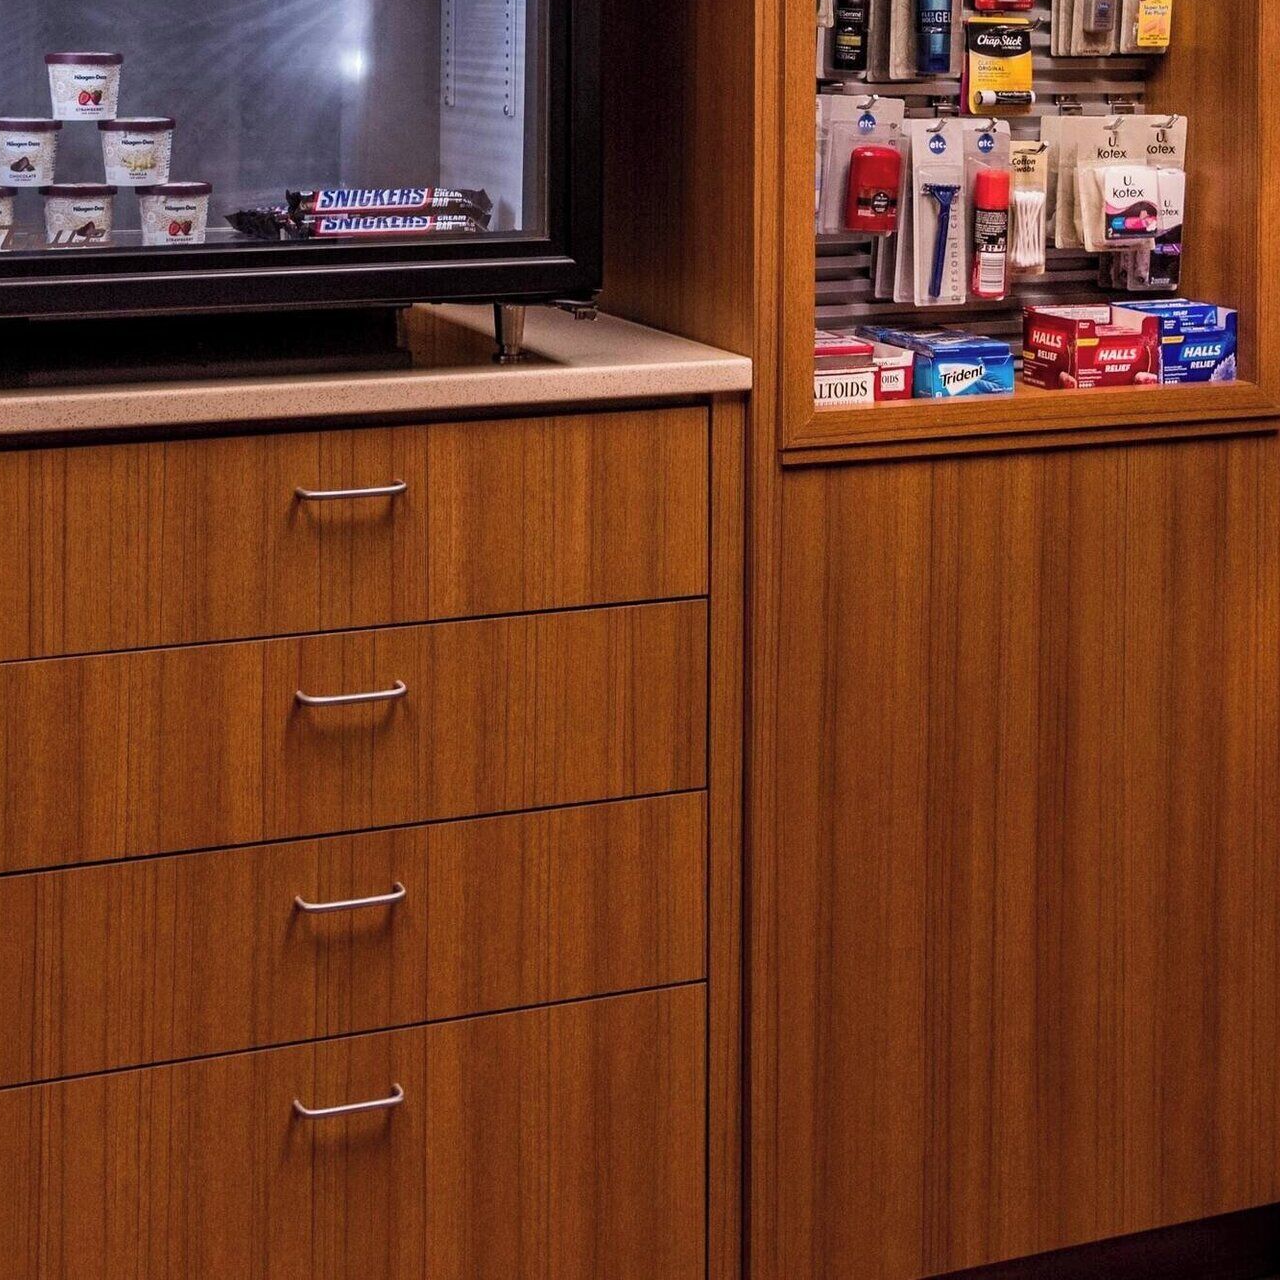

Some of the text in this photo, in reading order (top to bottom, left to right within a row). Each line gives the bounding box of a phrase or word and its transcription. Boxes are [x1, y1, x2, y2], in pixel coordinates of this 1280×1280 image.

[935, 11, 951, 23] GEL
[977, 34, 1021, 46] ChapStick
[1097, 148, 1127, 159] kotex
[1012, 158, 1036, 166] Cotton
[321, 188, 426, 207] SNICKERS
[1112, 188, 1144, 199] kotex
[1033, 331, 1062, 348] HALLS
[1037, 351, 1058, 362] RELIEF
[1098, 348, 1137, 362] HALLS
[1183, 344, 1221, 359] HALLS
[1105, 363, 1131, 374] RELIEF
[1190, 359, 1215, 369] RELIEF
[940, 366, 983, 387] Trident
